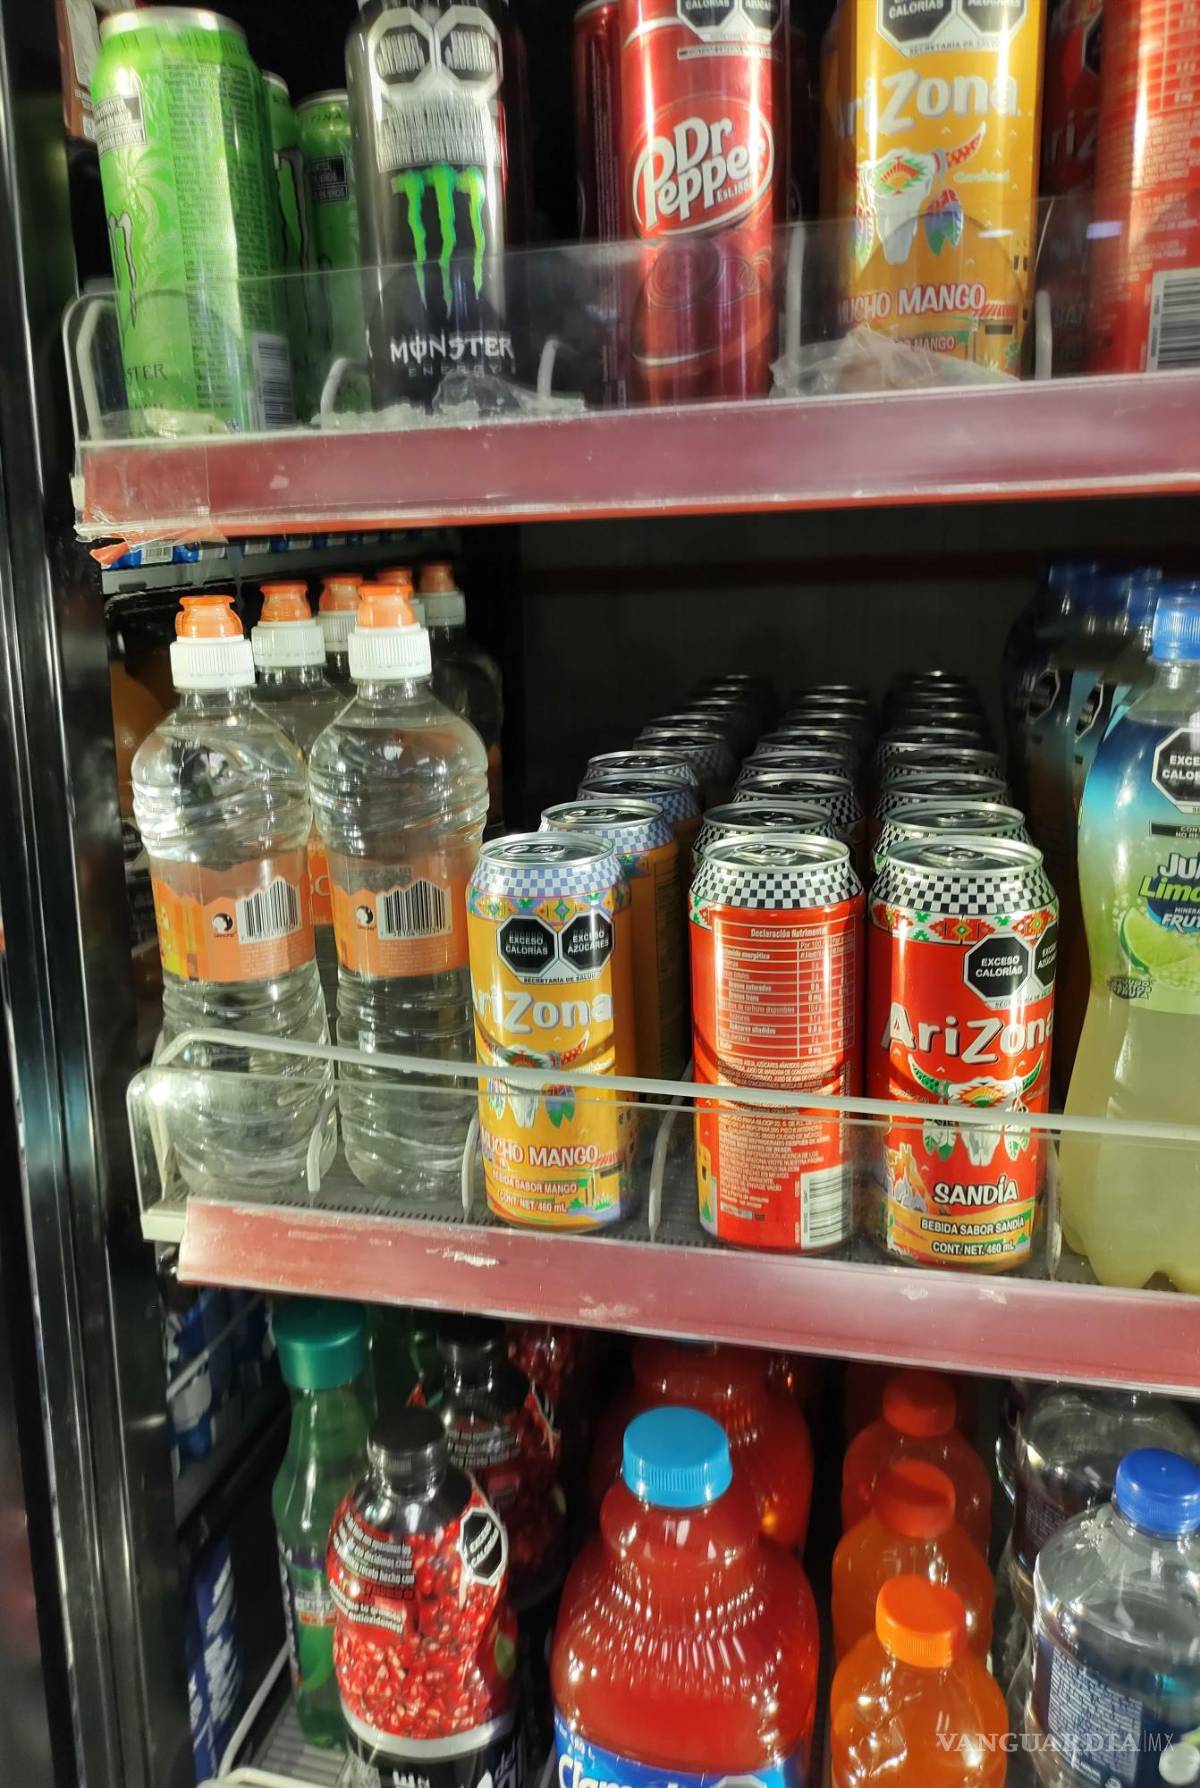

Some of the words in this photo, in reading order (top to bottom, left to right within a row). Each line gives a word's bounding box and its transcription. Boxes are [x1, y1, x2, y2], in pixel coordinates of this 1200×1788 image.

[673, 117, 733, 174] Dr
[641, 136, 767, 231] Pepper
[899, 284, 986, 315] MANGO
[389, 332, 515, 364] MONSTER
[913, 336, 956, 352] MANGO
[509, 936, 544, 945] EXCESO
[572, 930, 605, 943] EXCESO
[750, 928, 790, 938] Declaración
[505, 945, 548, 955] CALORÍAS
[567, 939, 609, 954] AZÚCARES
[981, 955, 1020, 967] EXCESO
[975, 965, 1023, 978] CALORÍAS
[477, 984, 612, 1034] riZona
[529, 1144, 599, 1167] MANGO
[515, 1180, 543, 1193] SABOR
[544, 1183, 578, 1194] MANGO
[933, 1175, 1018, 1206] SANDÍA
[921, 1219, 958, 1235] BEBIDA
[960, 1223, 994, 1235] SABOR
[995, 1215, 1025, 1233] SANDÍA
[932, 1241, 963, 1254] CONT.
[964, 1244, 986, 1255] NET.
